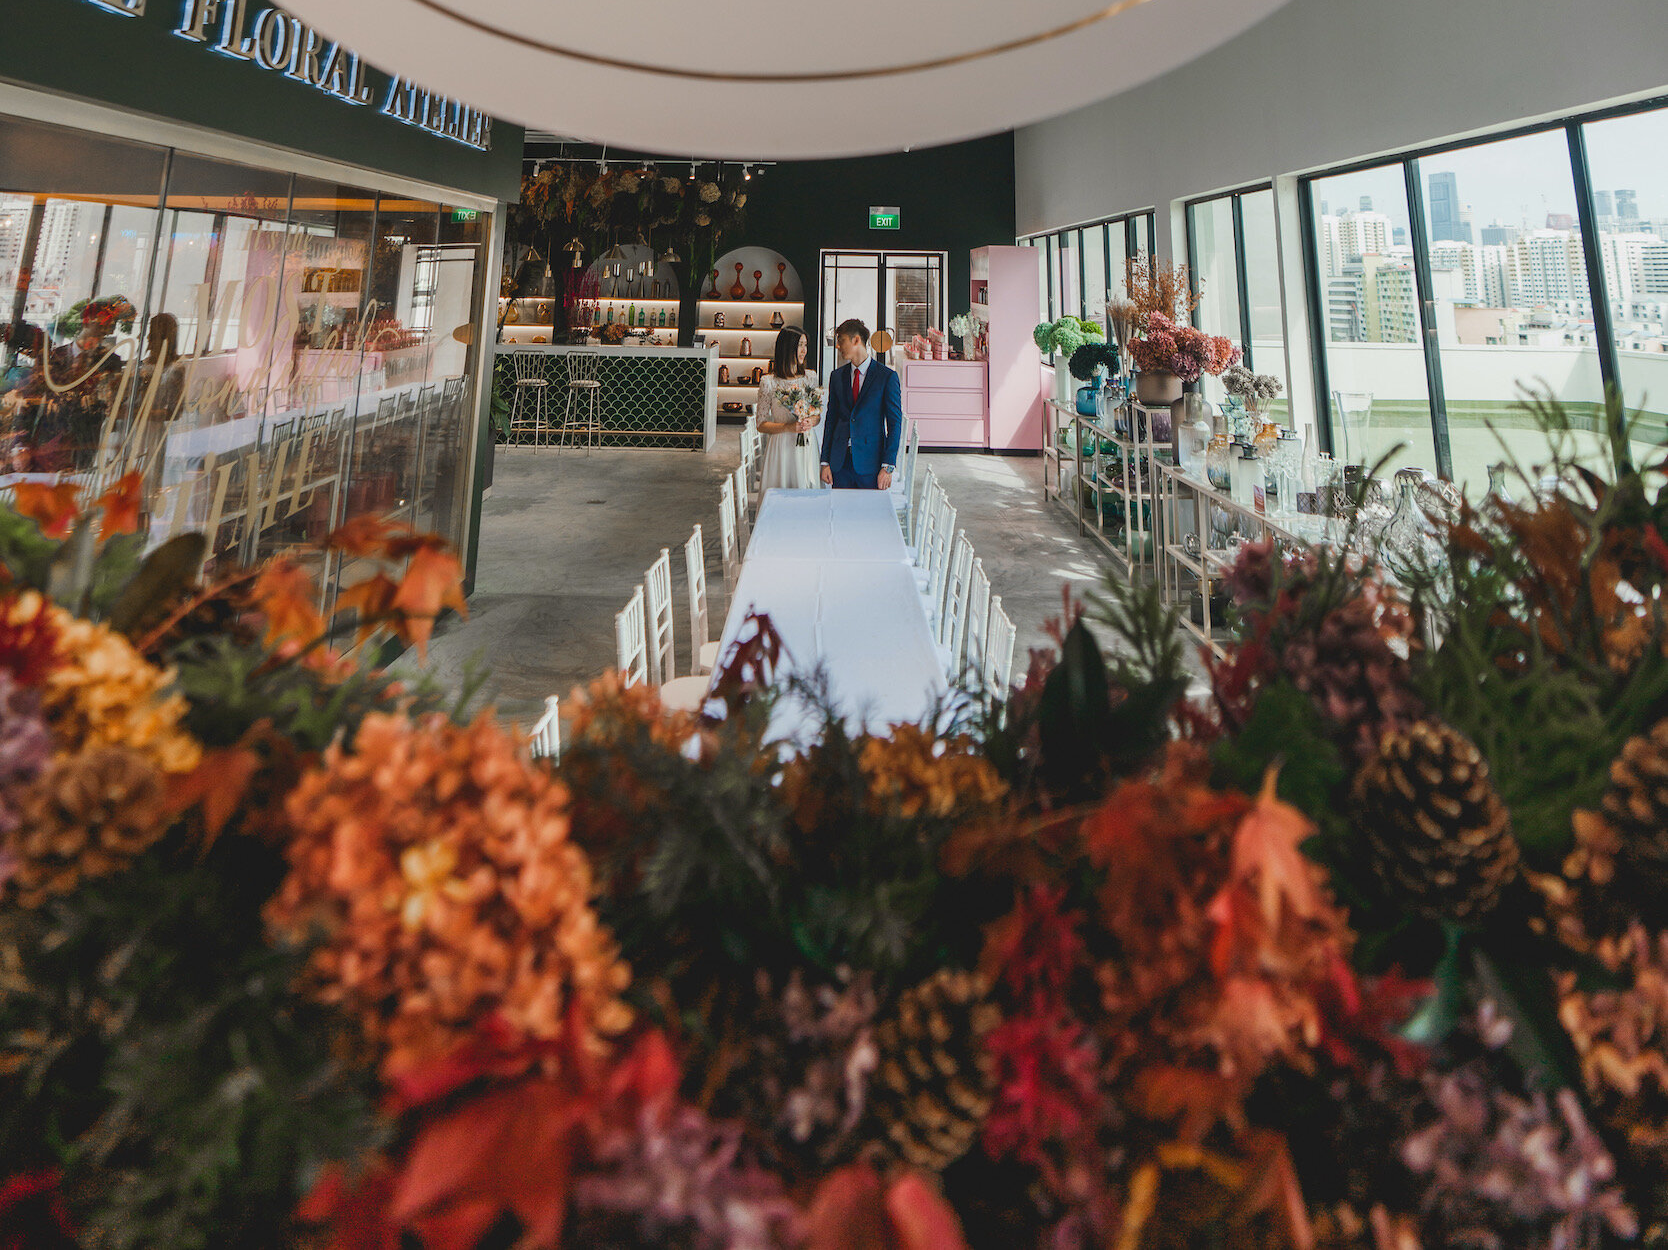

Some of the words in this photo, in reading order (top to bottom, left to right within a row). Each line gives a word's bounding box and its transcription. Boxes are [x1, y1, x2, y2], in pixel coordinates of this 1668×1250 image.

[876, 217, 893, 227] EXIT
[175, 257, 342, 364] MOST
[154, 423, 328, 563] TIME
